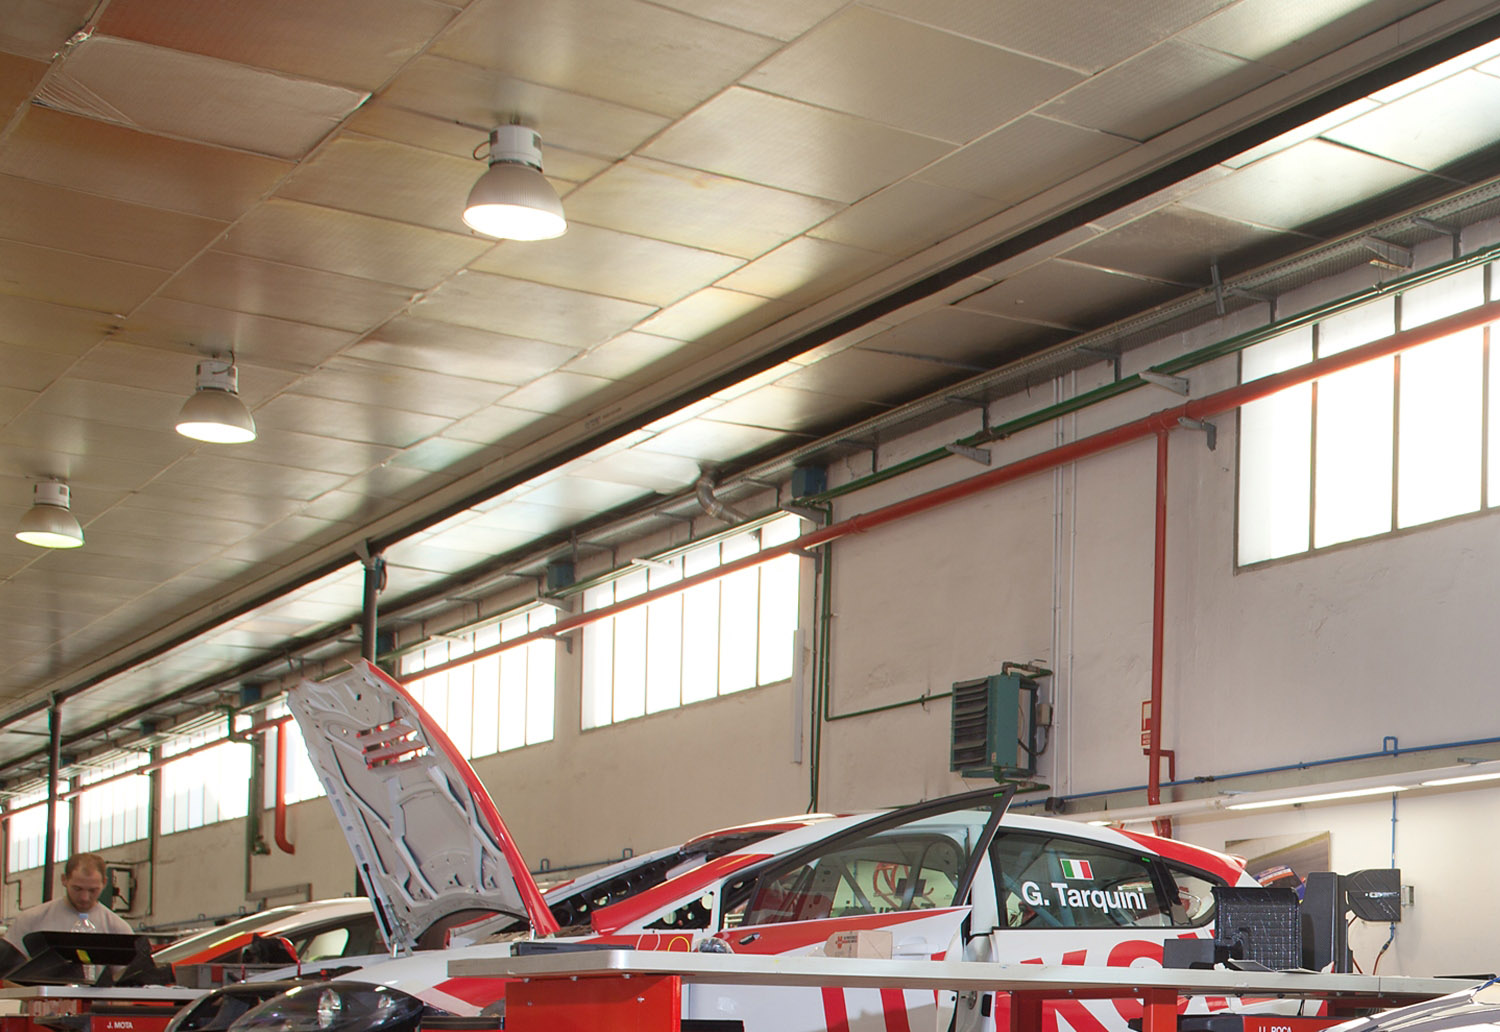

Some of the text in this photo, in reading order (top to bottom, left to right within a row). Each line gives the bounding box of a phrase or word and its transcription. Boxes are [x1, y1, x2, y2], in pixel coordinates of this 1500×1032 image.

[1021, 881, 1147, 914] G. Tarquini
[114, 1021, 133, 1029] MOTA
